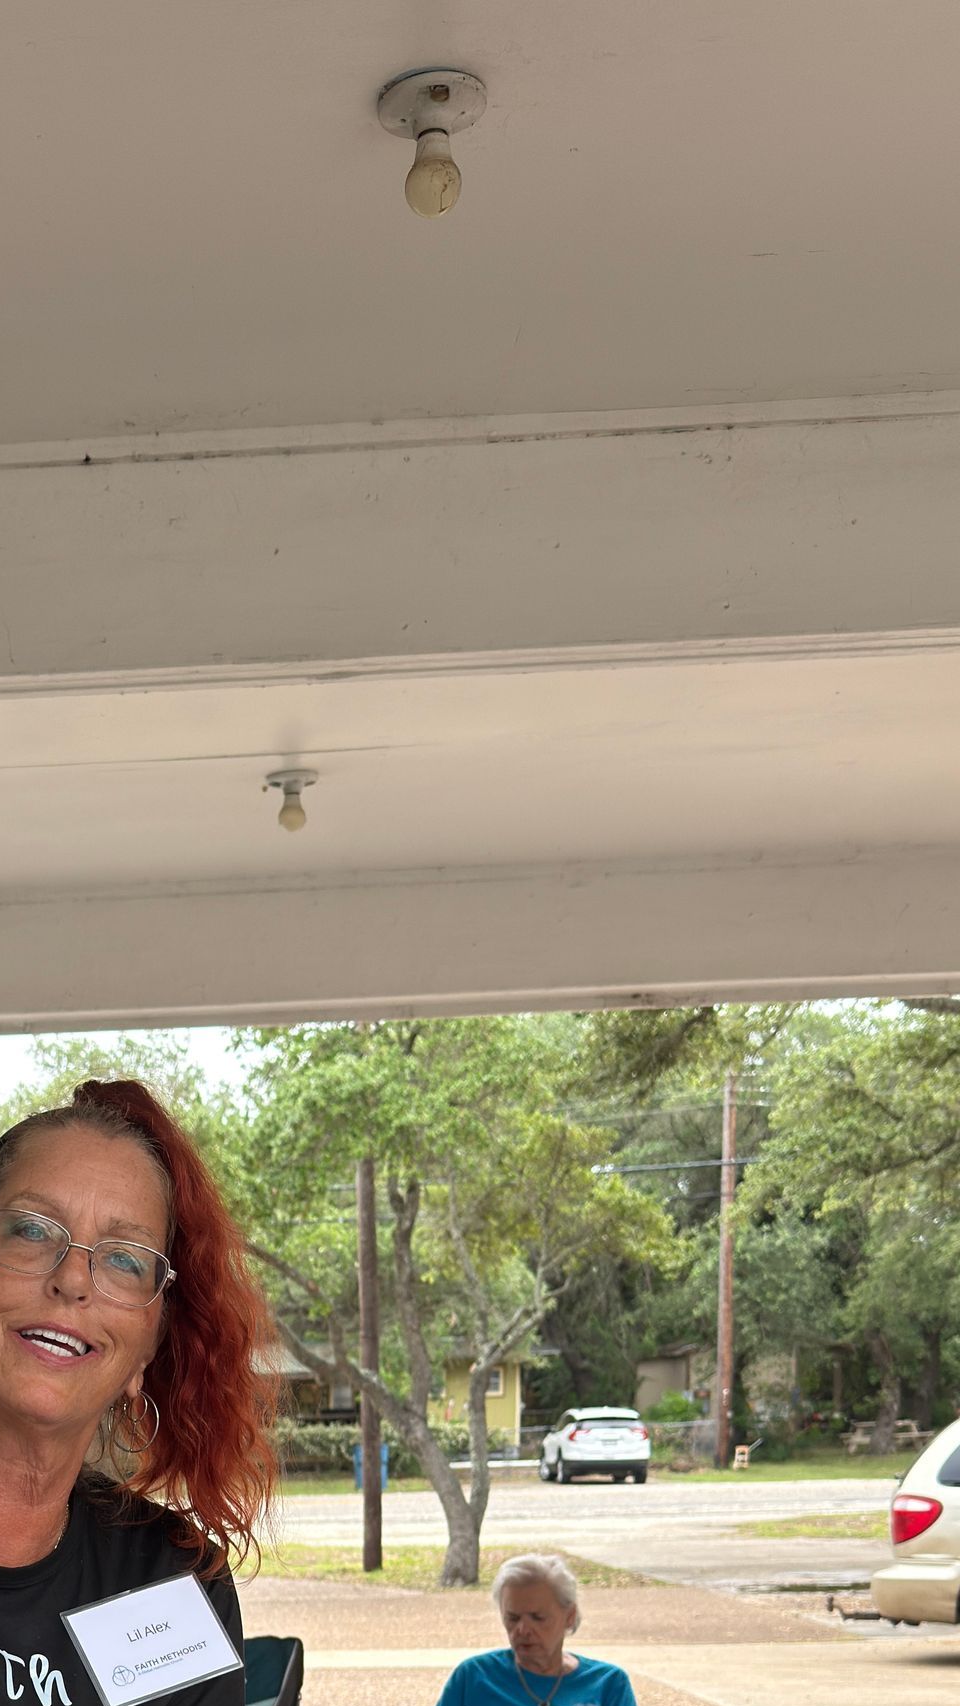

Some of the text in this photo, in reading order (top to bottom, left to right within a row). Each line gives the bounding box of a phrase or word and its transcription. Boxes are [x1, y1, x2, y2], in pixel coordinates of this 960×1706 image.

[126, 1621, 171, 1643] Lil Alex
[134, 1658, 159, 1672] FAITH
[160, 1640, 208, 1663] METHODIST
